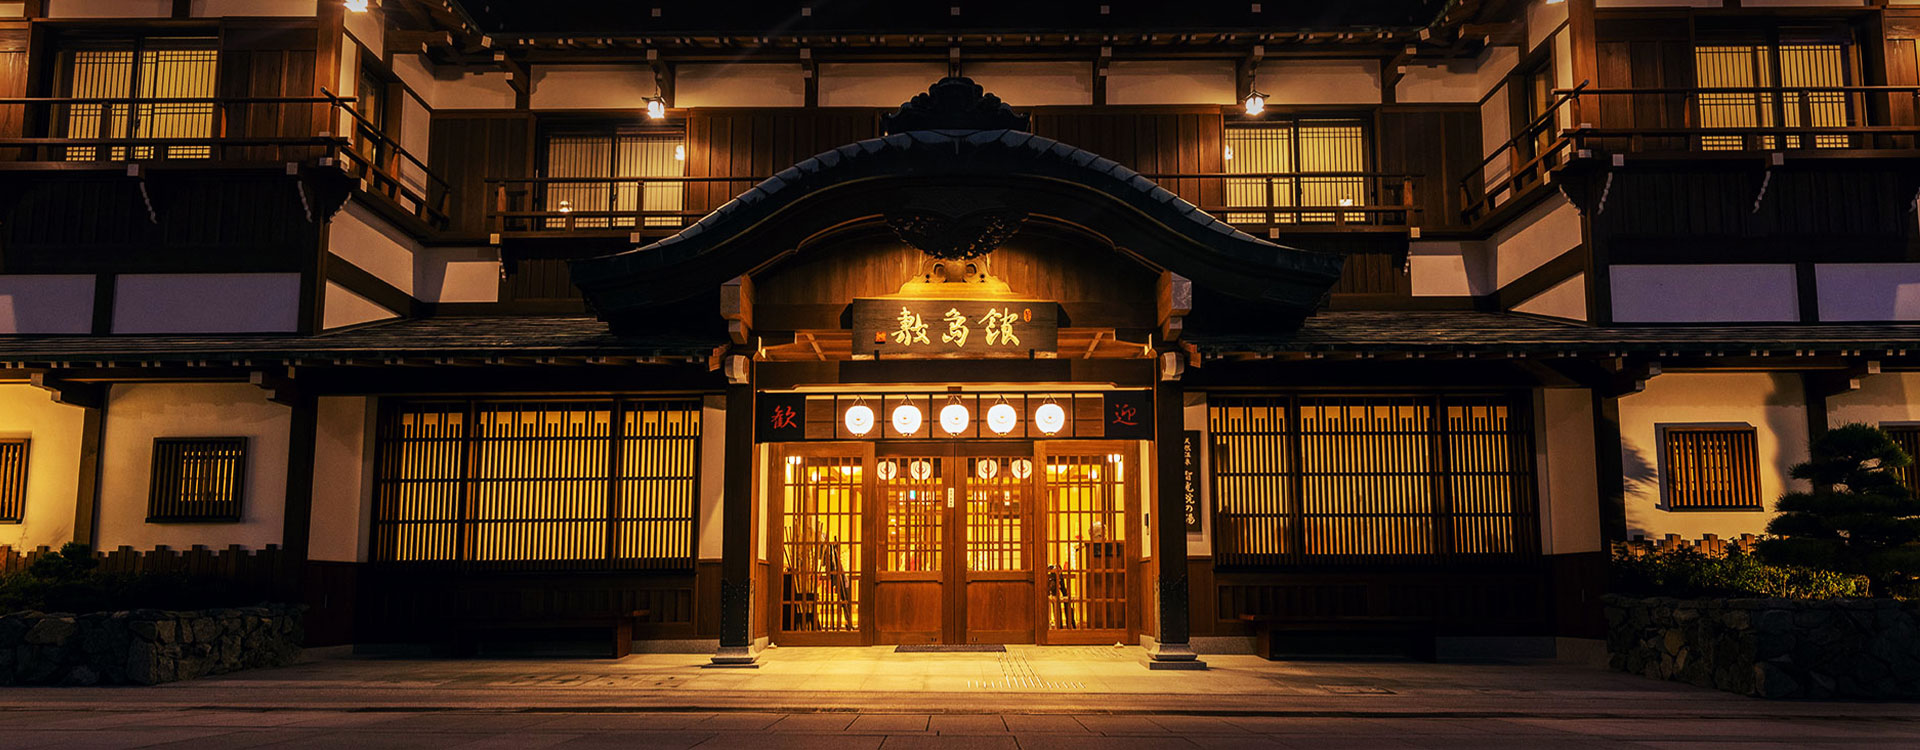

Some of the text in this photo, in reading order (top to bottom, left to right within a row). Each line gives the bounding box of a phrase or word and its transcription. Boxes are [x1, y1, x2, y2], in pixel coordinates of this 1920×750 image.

[891, 306, 1020, 348] 敷島館
[1112, 404, 1139, 426] 迎
